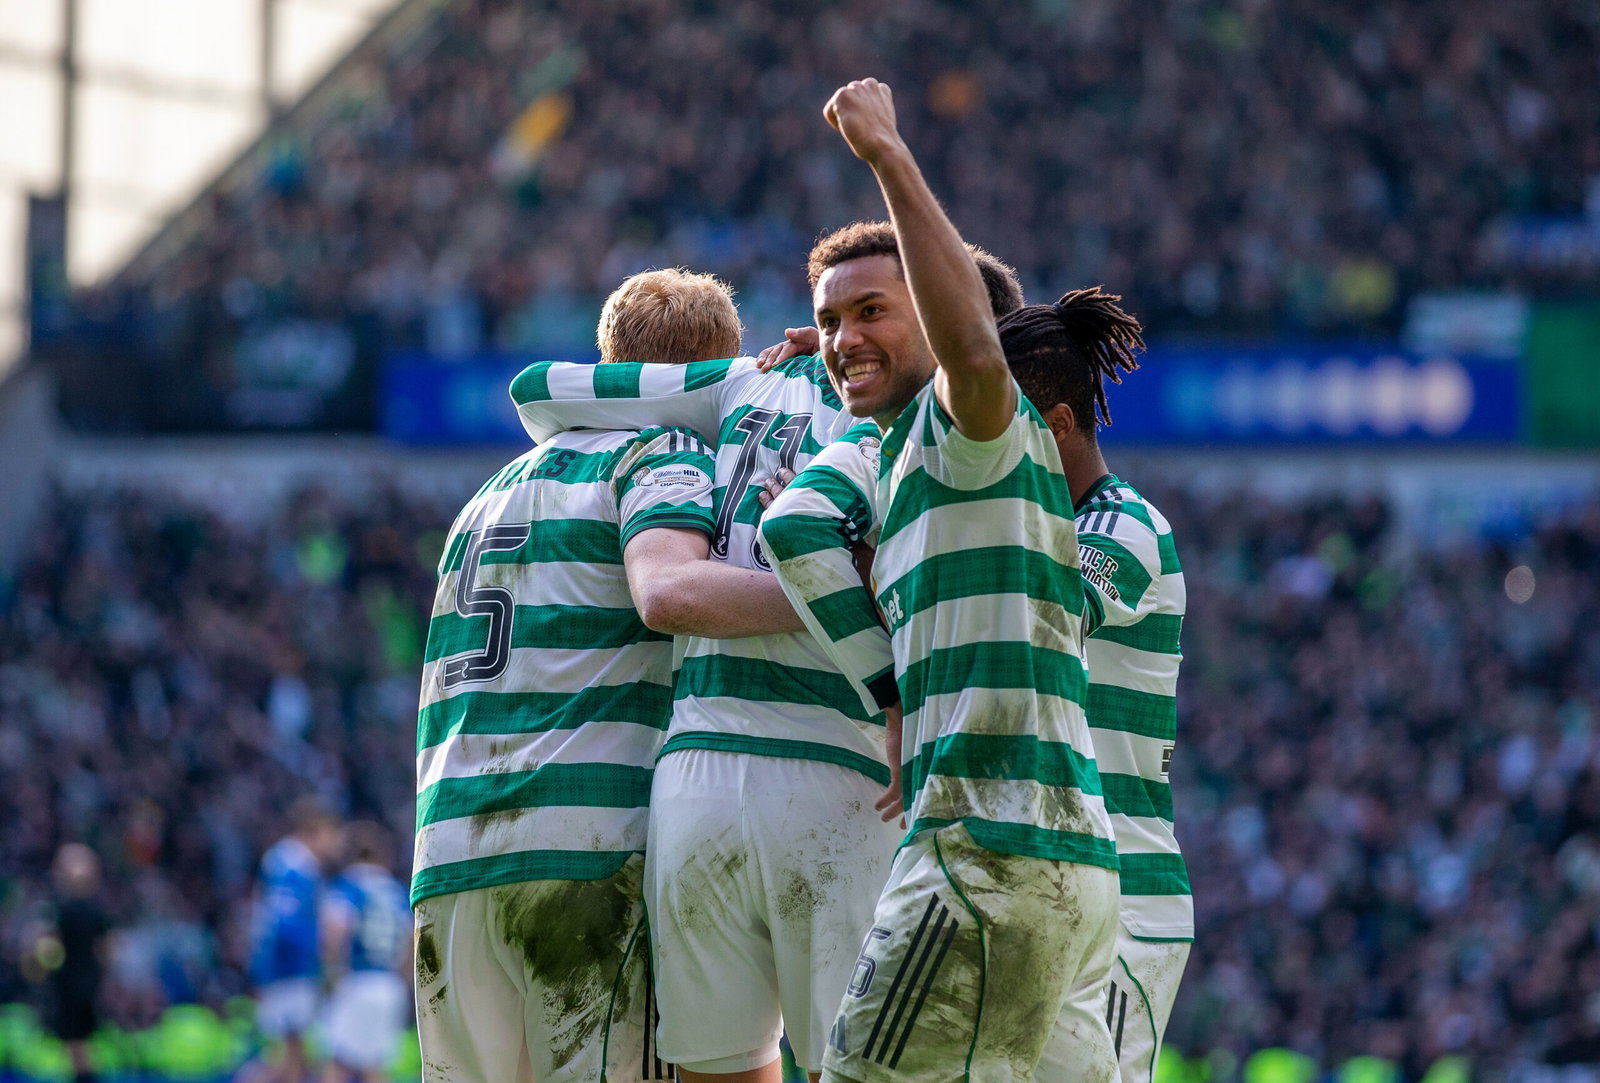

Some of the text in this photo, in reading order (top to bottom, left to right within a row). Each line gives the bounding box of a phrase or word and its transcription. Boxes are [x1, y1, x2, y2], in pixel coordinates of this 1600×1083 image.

[683, 469, 700, 477] HILL
[711, 409, 813, 572] 11
[1081, 563, 1119, 602] NDATION
[1100, 557, 1118, 579] FC
[443, 523, 532, 690] 5
